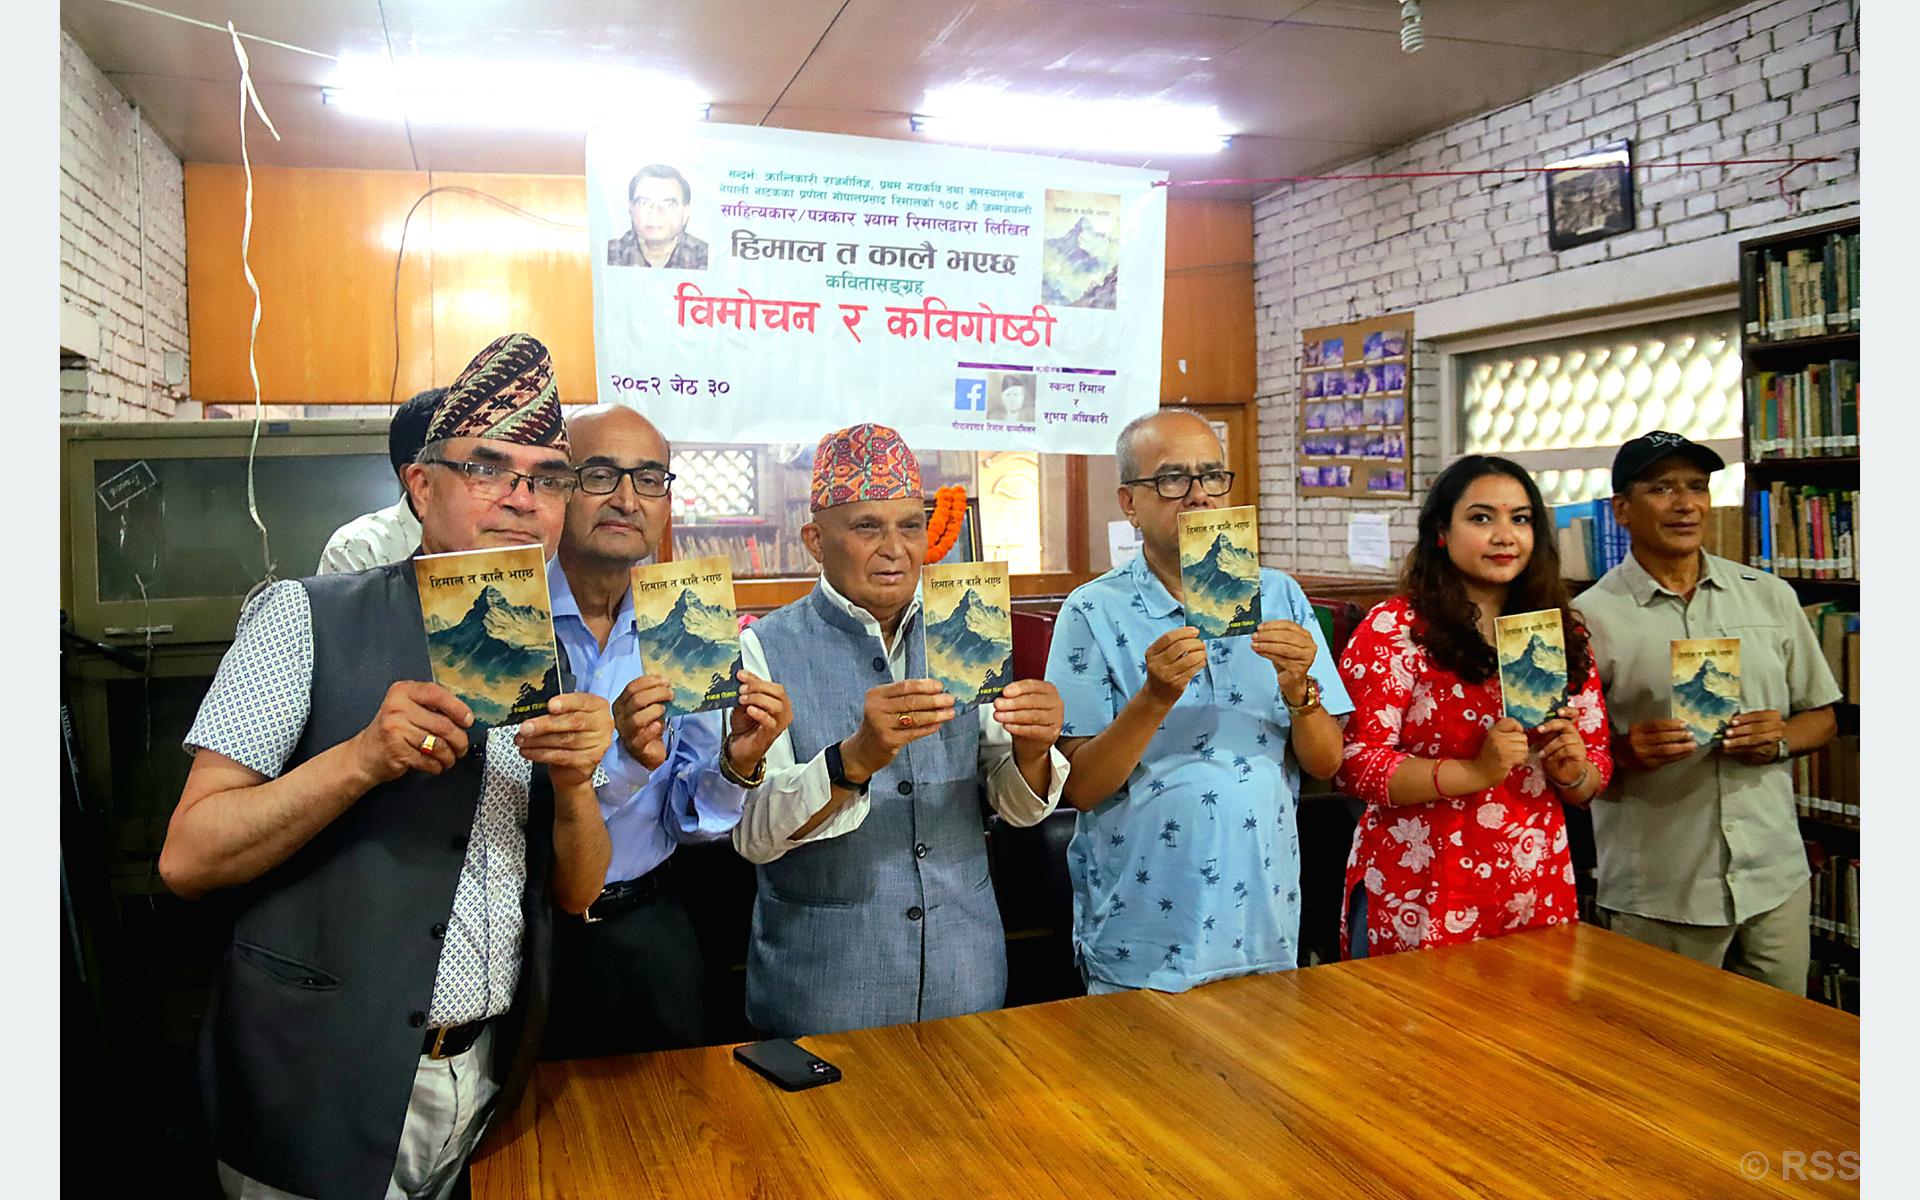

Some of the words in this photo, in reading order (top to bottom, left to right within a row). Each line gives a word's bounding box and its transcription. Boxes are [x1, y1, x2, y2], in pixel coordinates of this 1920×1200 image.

[946, 185, 964, 196] तथा
[720, 200, 857, 227] साहित्यकार/पत्रकार
[864, 212, 899, 228] श्याम
[906, 211, 978, 235] रिमालद्वारा
[984, 217, 1030, 237] लिखित
[731, 229, 827, 263] हिमाल
[836, 242, 859, 265] त
[868, 240, 937, 270] कालै
[946, 249, 1019, 276] भएछ
[825, 270, 925, 297] कवितासङ्ग्रह
[673, 282, 821, 334] विमोचन
[838, 303, 869, 343] र
[885, 296, 1057, 348] कविगोष्ठी
[611, 375, 661, 396] २०८२
[669, 374, 698, 396] जेठ
[708, 379, 730, 398] ३०
[1079, 381, 1105, 394] रिमाल
[429, 575, 464, 588] हिमाल
[467, 574, 477, 584] त
